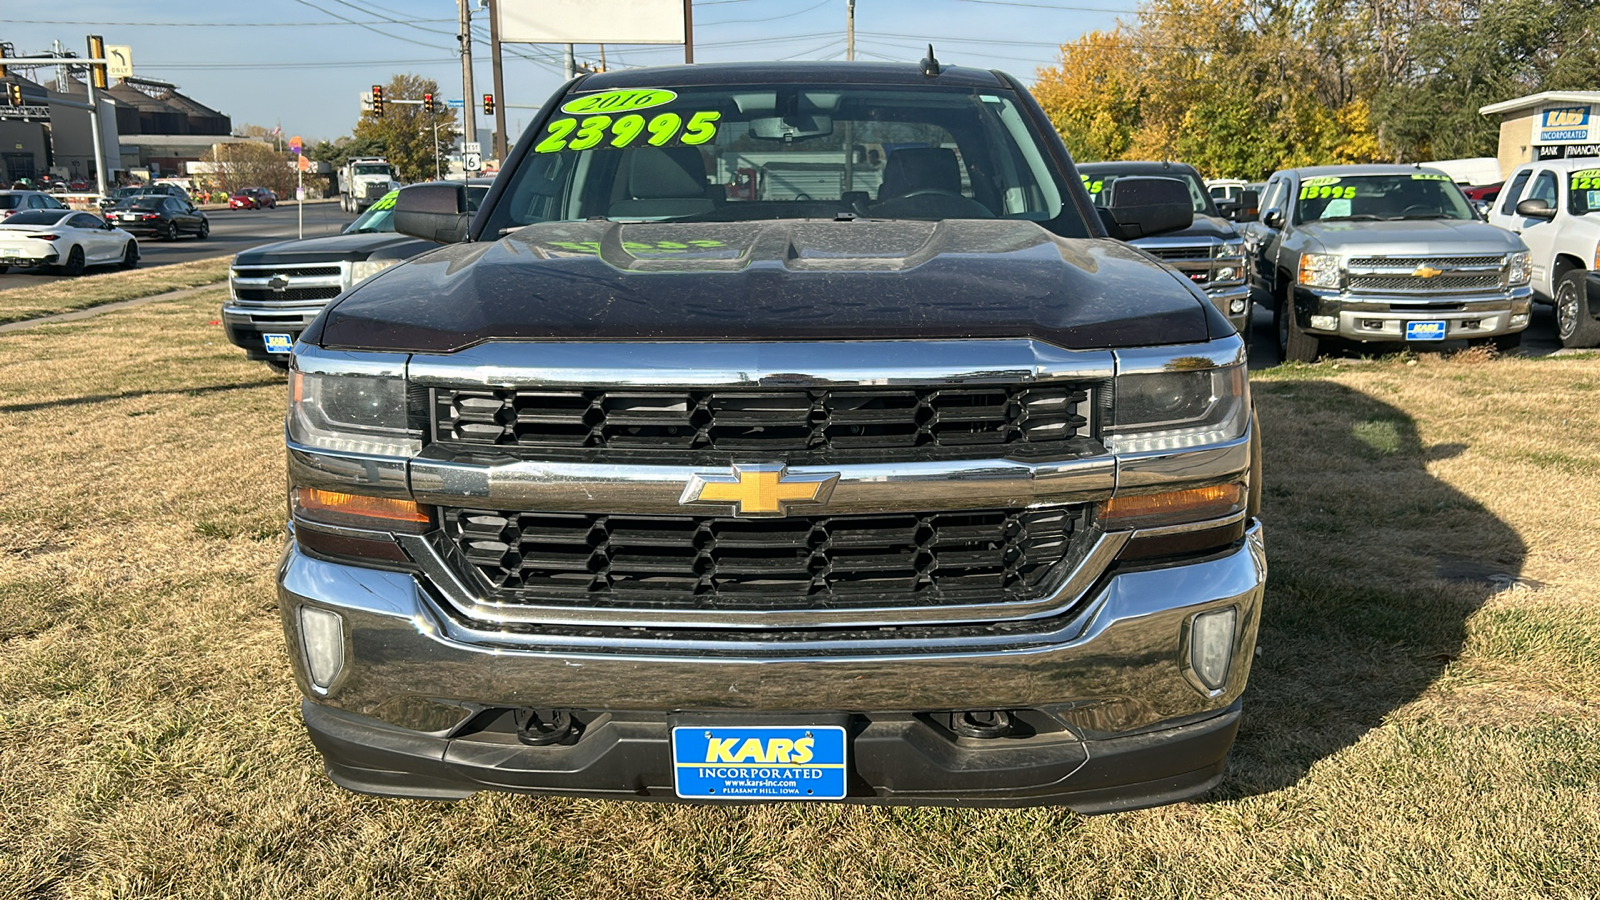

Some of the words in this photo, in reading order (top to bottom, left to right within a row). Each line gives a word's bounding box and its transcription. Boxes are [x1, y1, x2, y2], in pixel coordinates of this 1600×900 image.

[578, 92, 655, 111] 2016
[1547, 109, 1585, 126] KARS
[535, 111, 721, 153] 23995
[1541, 131, 1587, 140] INCORPORATED
[1541, 147, 1558, 155] BANK
[468, 157, 476, 168] 6
[1299, 186, 1356, 200] 13995
[705, 738, 815, 764] KARS
[699, 768, 823, 779] INCORPORATED
